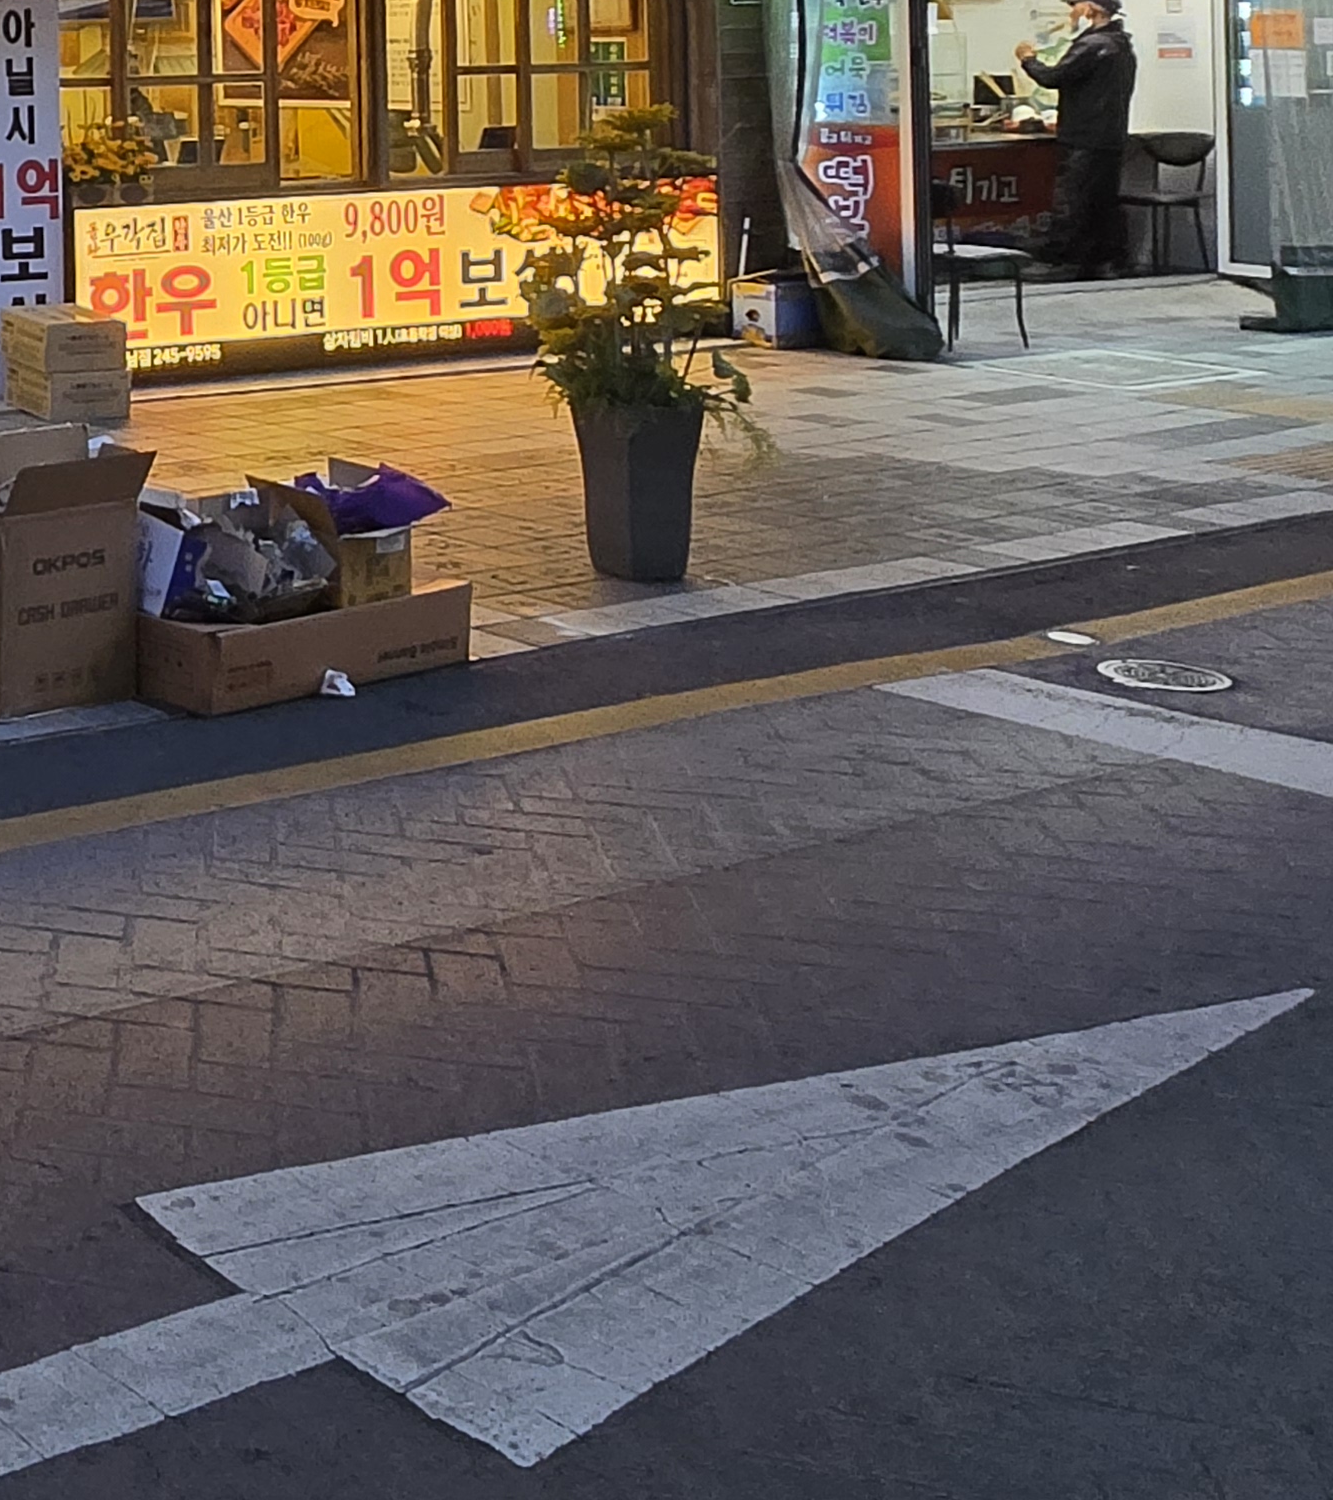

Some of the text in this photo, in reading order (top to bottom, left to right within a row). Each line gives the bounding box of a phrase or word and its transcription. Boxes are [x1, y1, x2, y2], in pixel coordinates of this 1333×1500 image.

[99, 216, 167, 252] 우각집
[200, 193, 447, 243] 울산 1등급 한우 9,800원
[200, 229, 333, 257] 최저가 도전!! (100g)
[89, 253, 327, 340] 한우 1등급
[242, 295, 327, 332] 아니면
[349, 247, 442, 320] 1억
[152, 343, 222, 367] 245-9595
[32, 548, 106, 577] OKPOS
[17, 603, 56, 627] CASH
